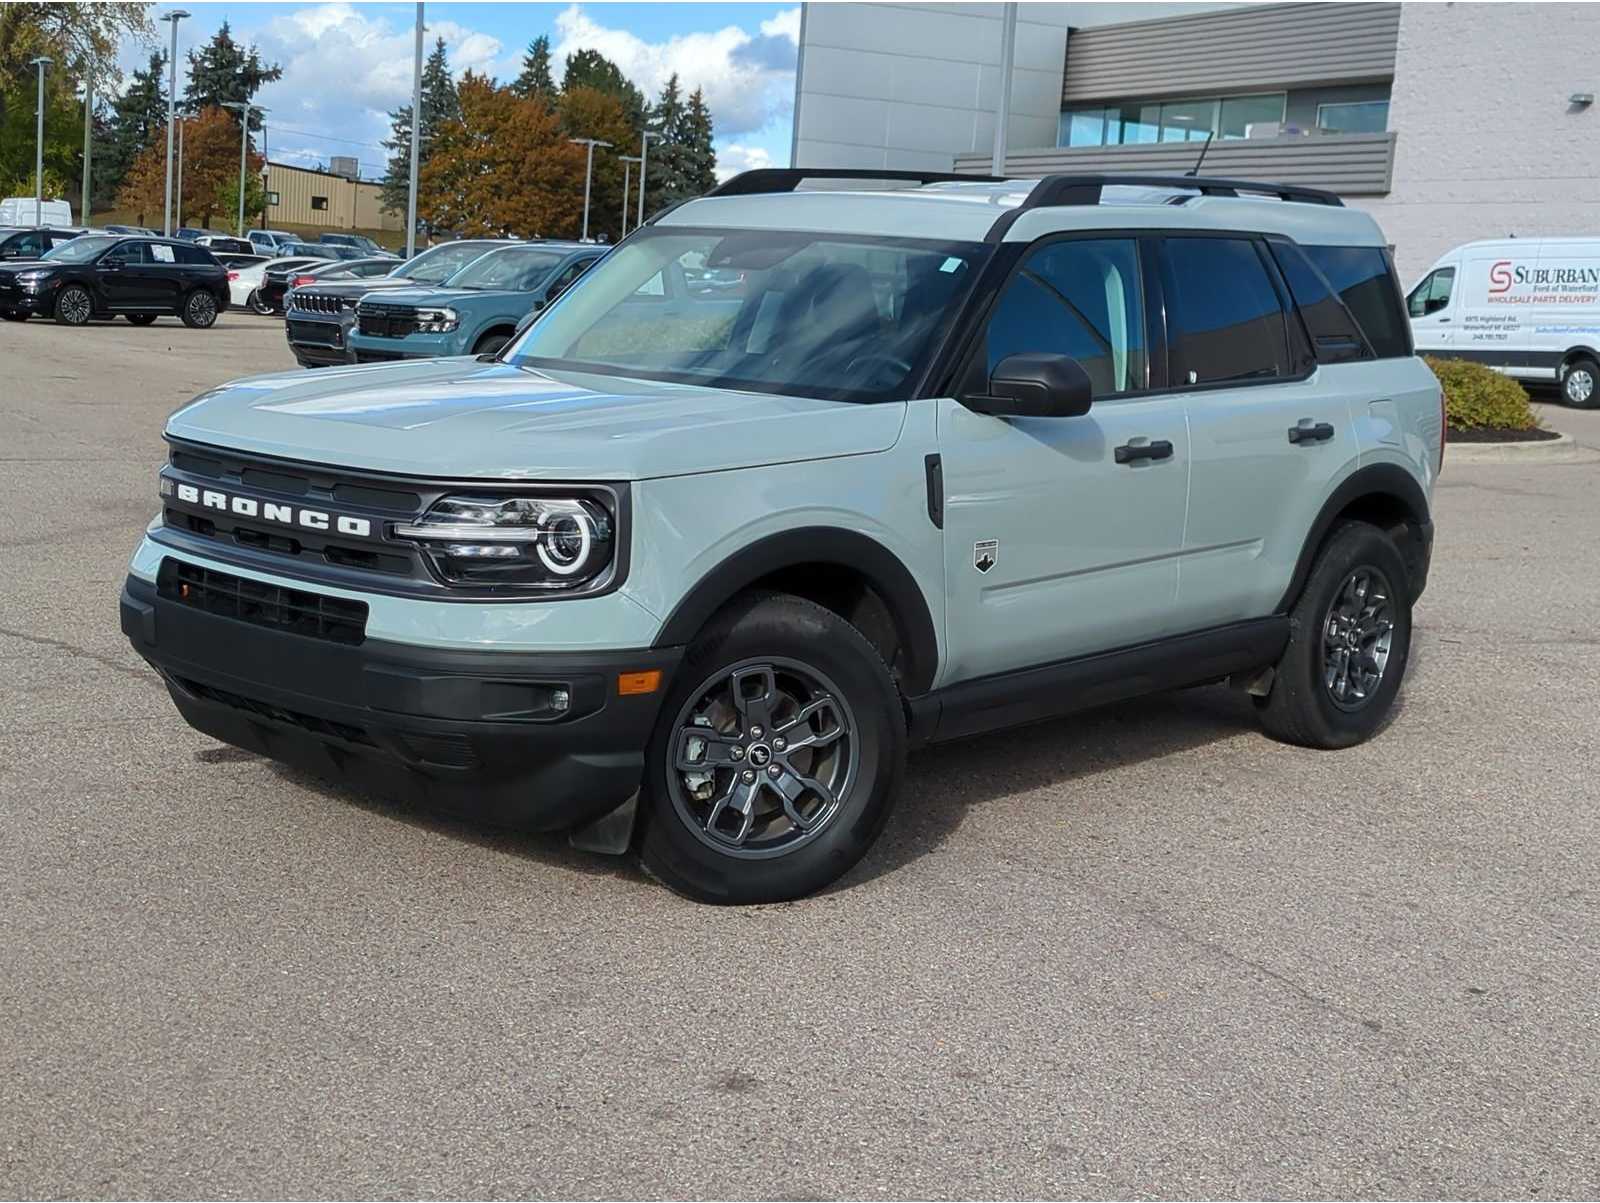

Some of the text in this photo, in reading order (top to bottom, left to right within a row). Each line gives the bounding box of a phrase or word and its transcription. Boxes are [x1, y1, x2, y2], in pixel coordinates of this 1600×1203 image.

[1513, 265, 1600, 284] SUBURBAN
[1551, 284, 1559, 292] of
[1561, 284, 1599, 292] Waterford
[1558, 295, 1597, 303] DELIVERY
[178, 483, 371, 537] BRONCO
